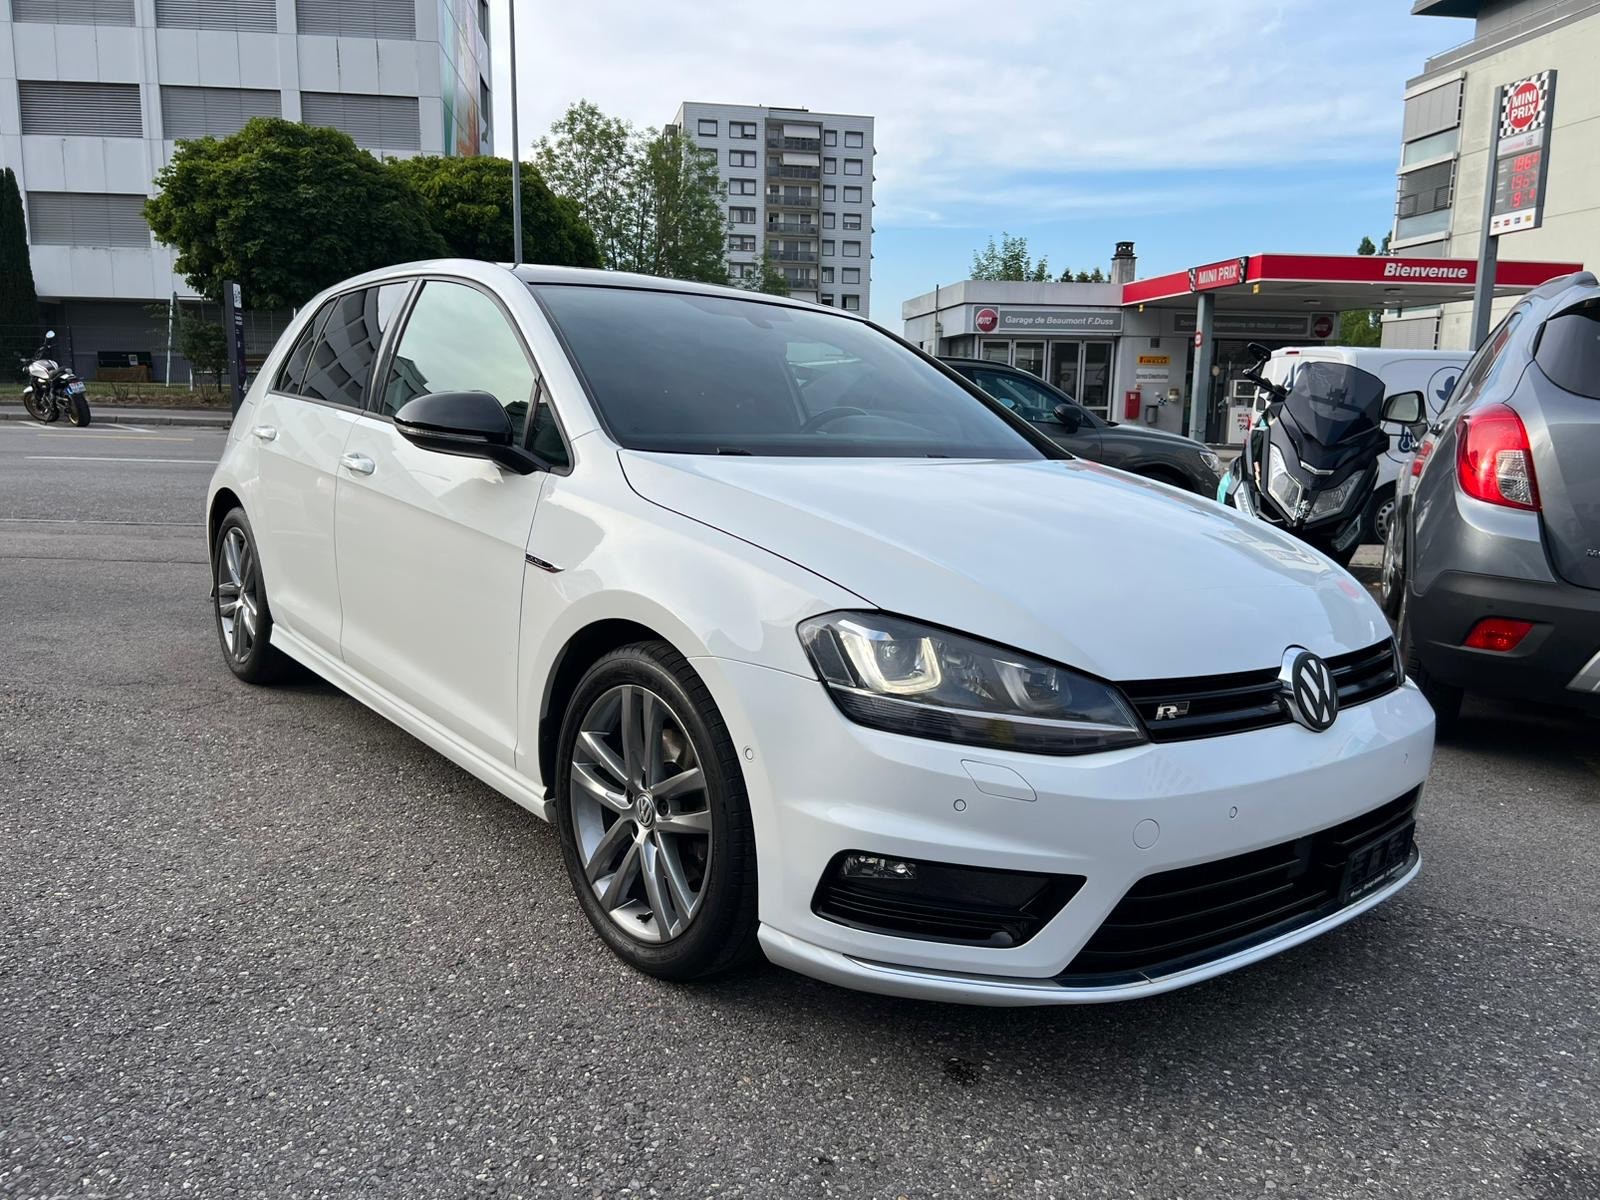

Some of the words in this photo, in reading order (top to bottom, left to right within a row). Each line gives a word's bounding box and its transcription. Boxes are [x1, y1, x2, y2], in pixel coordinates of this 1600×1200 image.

[1511, 89, 1537, 108] MINI
[1511, 102, 1537, 121] PRIX
[1198, 268, 1217, 284] MINI
[1218, 264, 1238, 281] PRIX
[1383, 262, 1468, 279] Bienvenue
[1005, 316, 1033, 325] Garage
[1034, 316, 1045, 324] de
[1046, 316, 1086, 325] Beaumont
[1155, 705, 1178, 720] R
